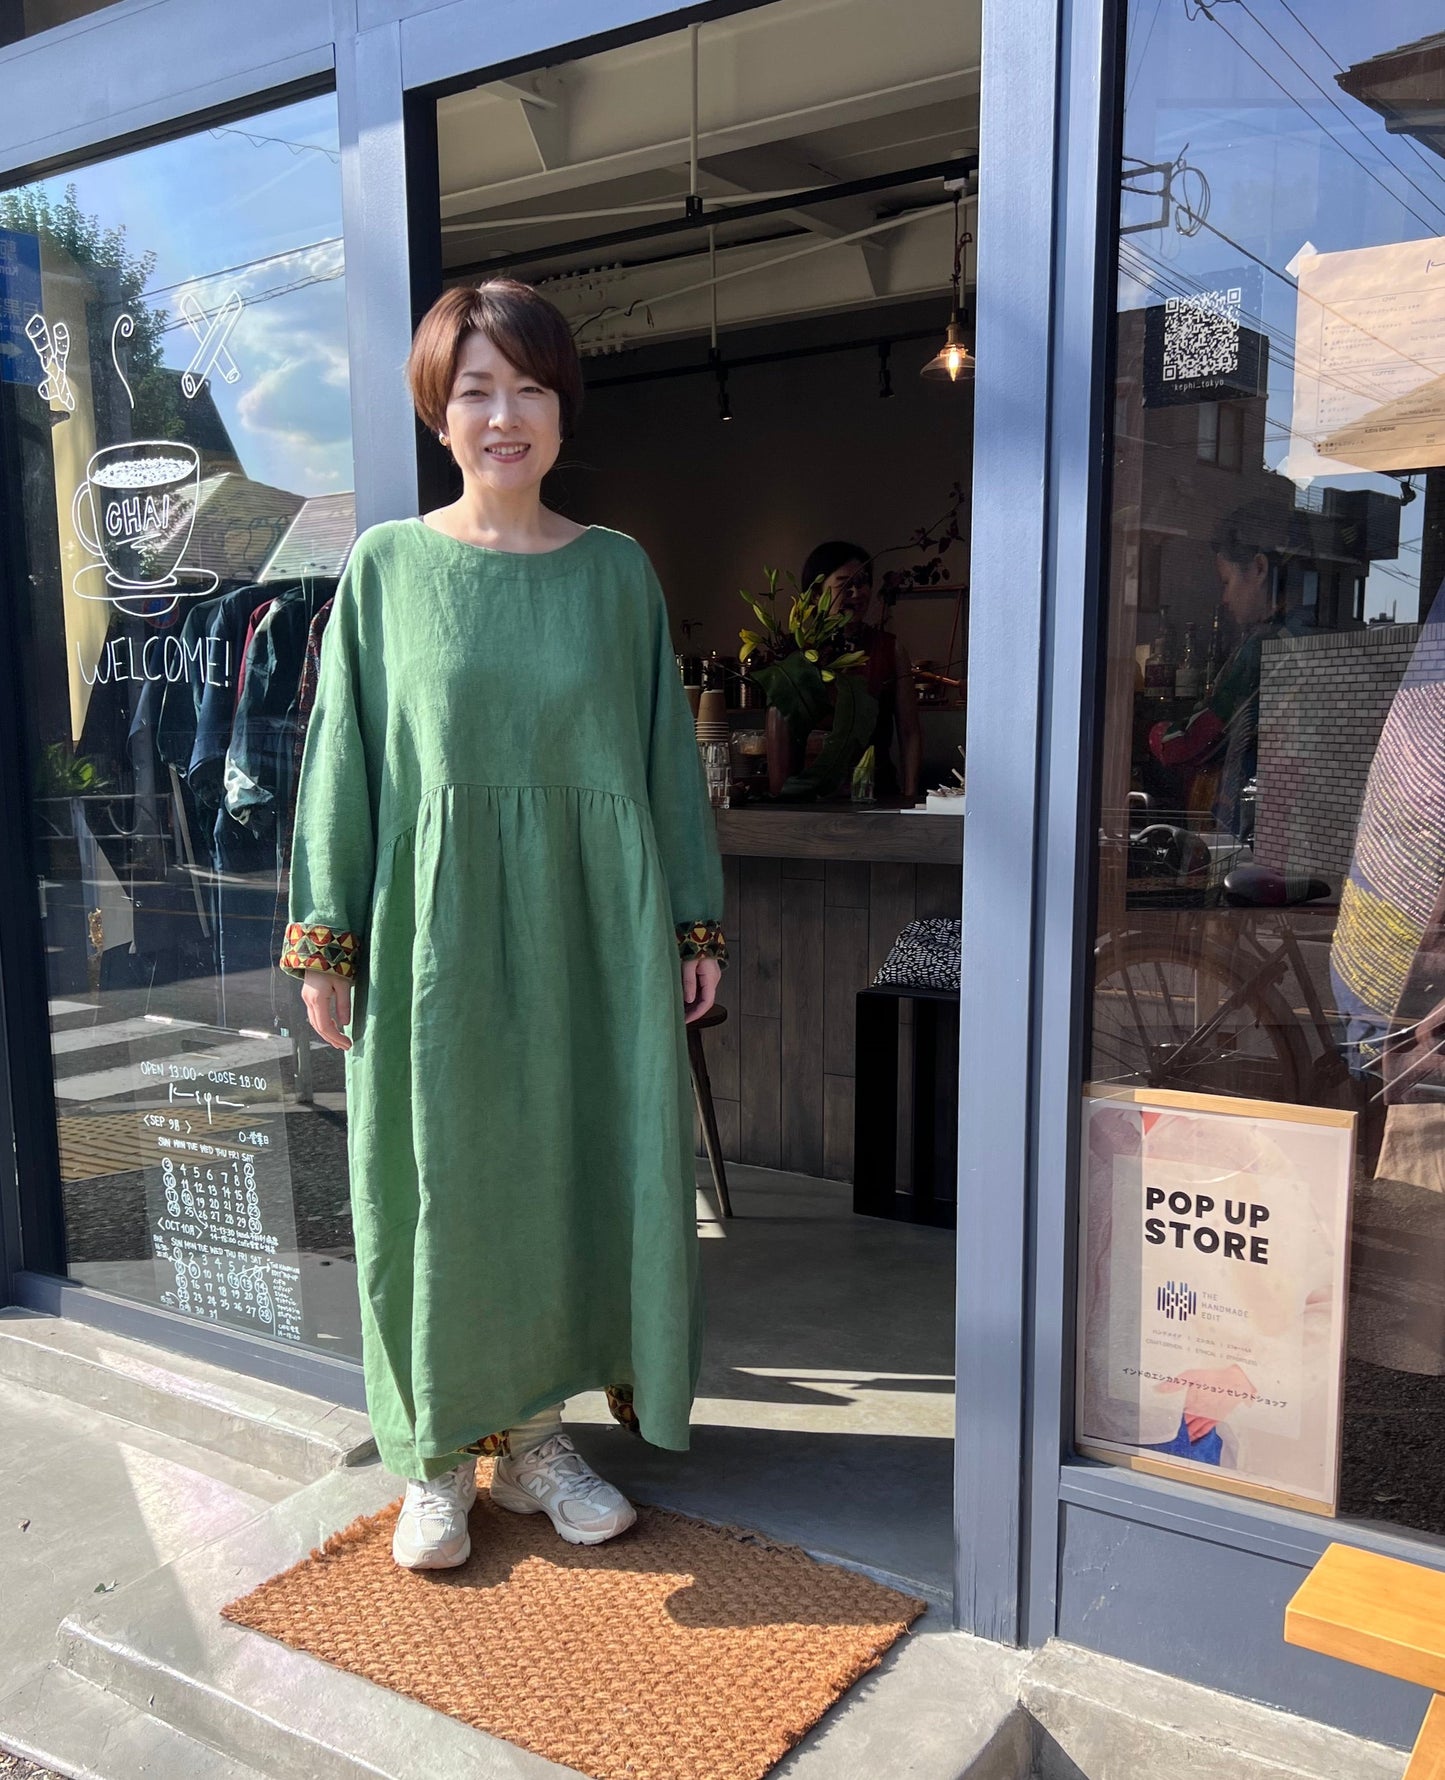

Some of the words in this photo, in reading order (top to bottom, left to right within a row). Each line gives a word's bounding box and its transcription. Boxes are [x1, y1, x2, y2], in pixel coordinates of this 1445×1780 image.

[1174, 379, 1225, 393] kephi_tokyo
[106, 494, 170, 537] CHAI
[76, 635, 230, 689] WELCOME!
[140, 1061, 164, 1076] OPEN
[208, 1070, 237, 1086] CLOSE
[239, 1075, 267, 1090] 18:00
[158, 1137, 171, 1148] SUN
[186, 1142, 198, 1151] TUE
[200, 1144, 213, 1155] WED
[215, 1148, 227, 1158] THU
[228, 1150, 239, 1160] FRI
[242, 1153, 254, 1163] SAT
[180, 1163, 187, 1176] 4
[193, 1167, 200, 1178] 5
[206, 1169, 214, 1181] 6
[220, 1172, 228, 1183] 7
[234, 1175, 240, 1186] 8
[232, 1162, 238, 1172] 1
[181, 1179, 189, 1190] 11
[193, 1182, 205, 1193] 12
[207, 1185, 217, 1196] 13
[222, 1186, 231, 1199] 14
[234, 1190, 243, 1200] 15
[195, 1197, 205, 1209] 19
[209, 1198, 220, 1210] 20
[223, 1200, 231, 1211] 21
[235, 1203, 246, 1214] 22
[1145, 1187, 1214, 1219] POP
[1225, 1200, 1270, 1229] UP
[184, 1206, 194, 1217] 25
[198, 1210, 208, 1220] 26
[210, 1211, 220, 1222] 27
[225, 1213, 235, 1225] 28
[236, 1216, 246, 1228] 29
[170, 1237, 183, 1248] SUN
[197, 1243, 209, 1253] TUE
[210, 1246, 223, 1255] WED
[224, 1249, 236, 1258] THU
[238, 1252, 247, 1262] FRI
[250, 1255, 262, 1264] SAT
[1145, 1218, 1269, 1265] STORE
[202, 1254, 208, 1265] 3
[214, 1257, 222, 1269] 4
[229, 1261, 235, 1271] 5
[203, 1269, 211, 1279] 10
[216, 1272, 224, 1283] 11
[191, 1280, 200, 1289] 16
[204, 1283, 213, 1292] 17
[218, 1286, 227, 1296] 18
[231, 1290, 240, 1299] 19
[244, 1292, 253, 1301] 20
[1201, 1291, 1219, 1302] THE
[193, 1292, 202, 1303] 23
[207, 1296, 217, 1306] 24
[233, 1302, 242, 1311] 26
[245, 1305, 257, 1318] 27
[1201, 1301, 1249, 1318] HANDMADE
[1201, 1311, 1221, 1322] EDIT
[528, 1476, 551, 1498] N
